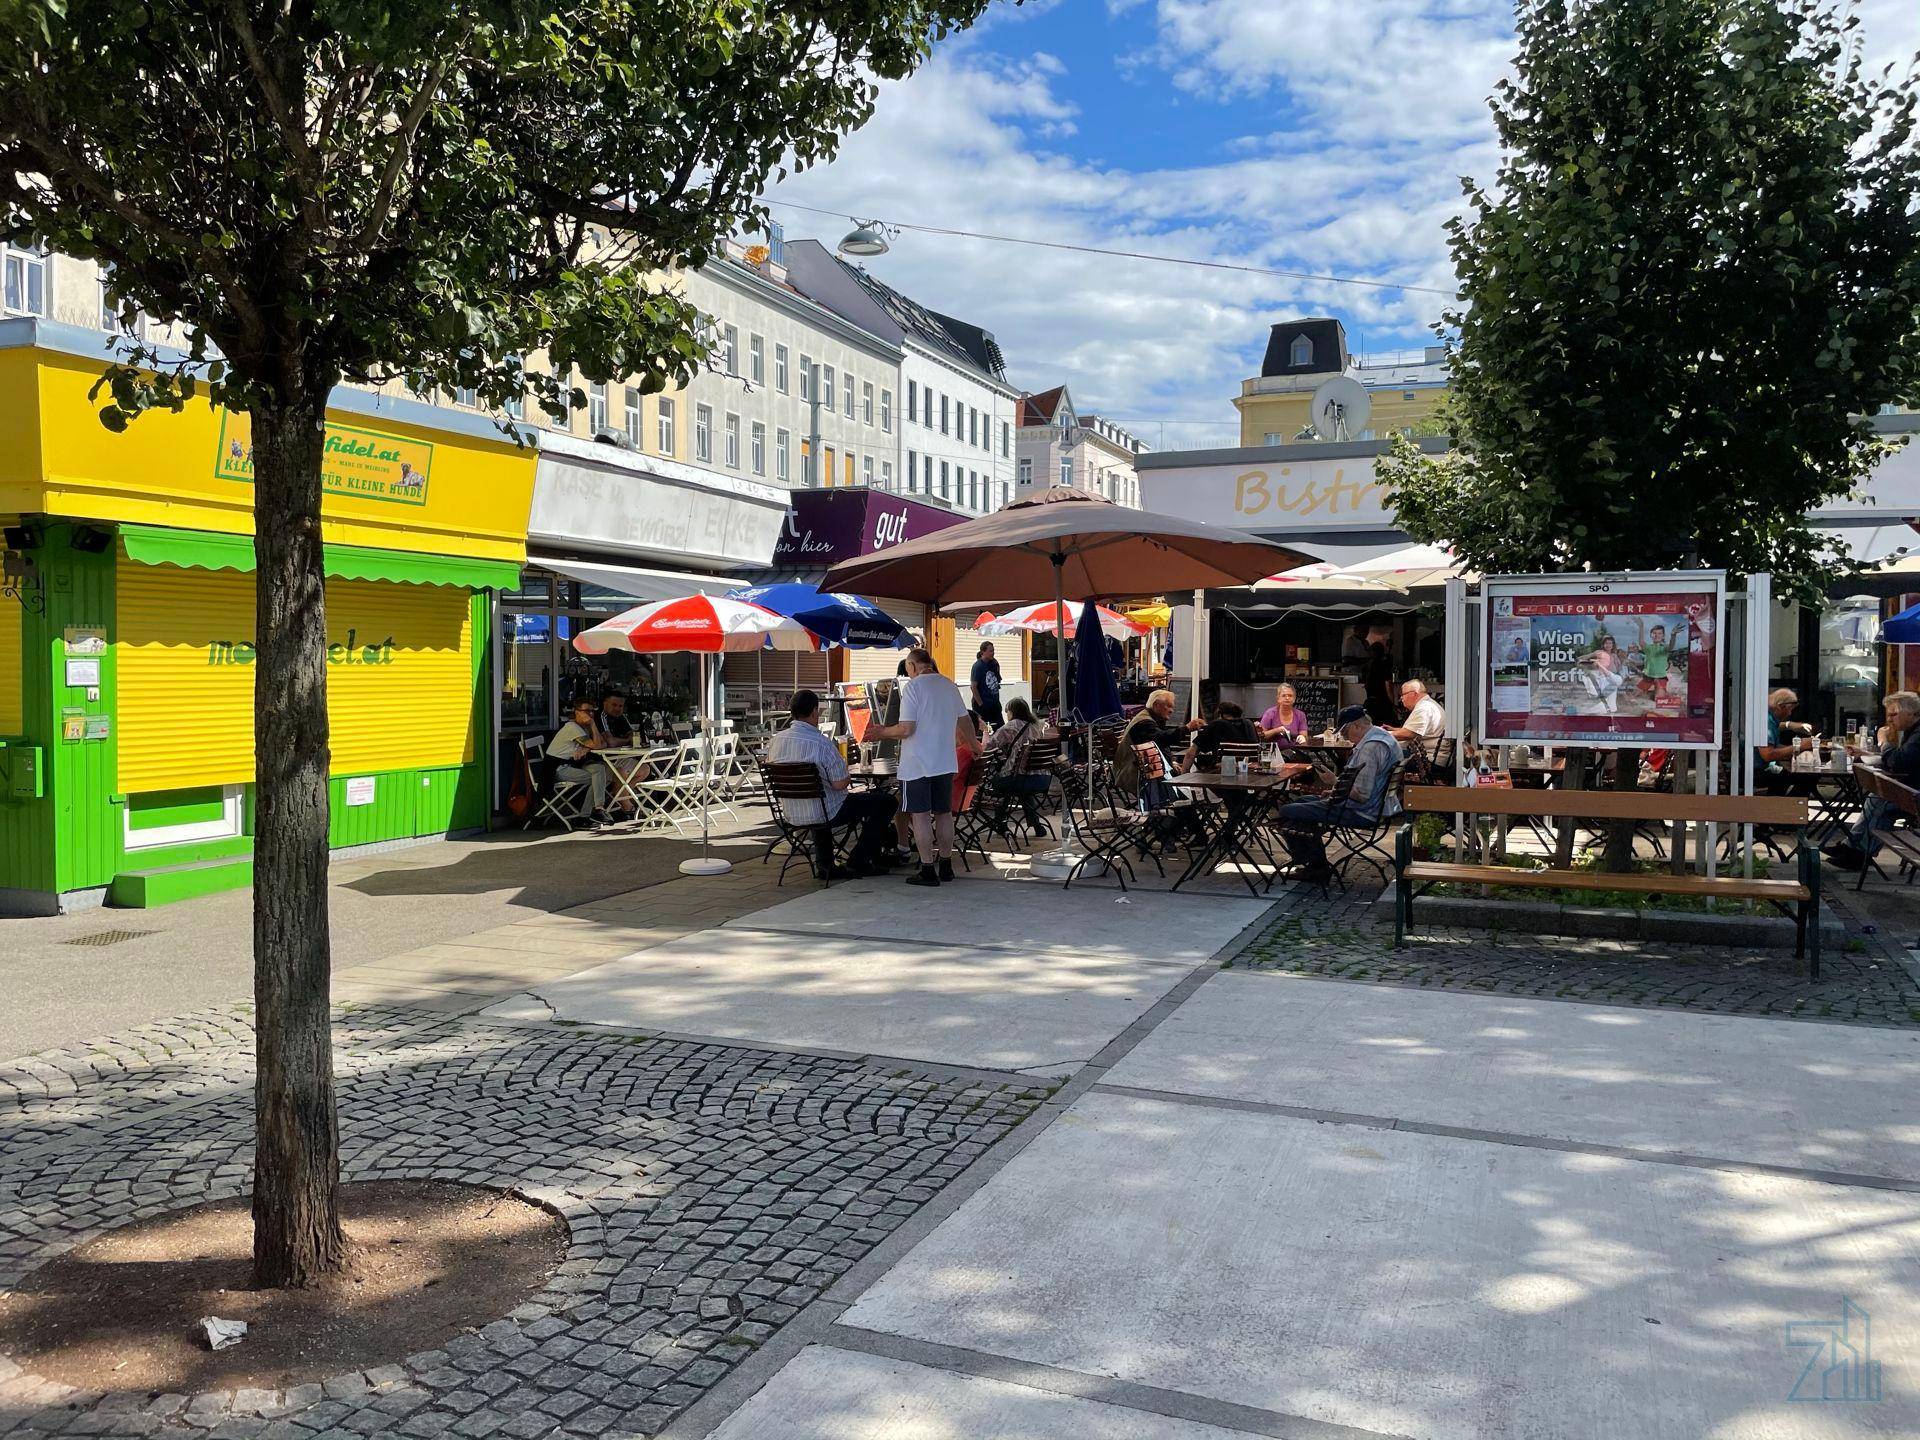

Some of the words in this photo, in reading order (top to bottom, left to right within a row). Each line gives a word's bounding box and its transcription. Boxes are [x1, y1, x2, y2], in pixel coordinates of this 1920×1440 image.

[324, 436, 402, 462] fidel.at
[224, 458, 253, 473] KLEI
[348, 476, 386, 494] KLEINE
[389, 483, 423, 498] HUNDE
[704, 506, 759, 545] ECKE
[775, 542, 796, 553] on
[800, 529, 835, 553] hier
[1589, 584, 1610, 593] SPÖ
[1550, 604, 1644, 614] INFORMIERT
[1538, 630, 1585, 645] Wien
[1537, 648, 1576, 666] gibt
